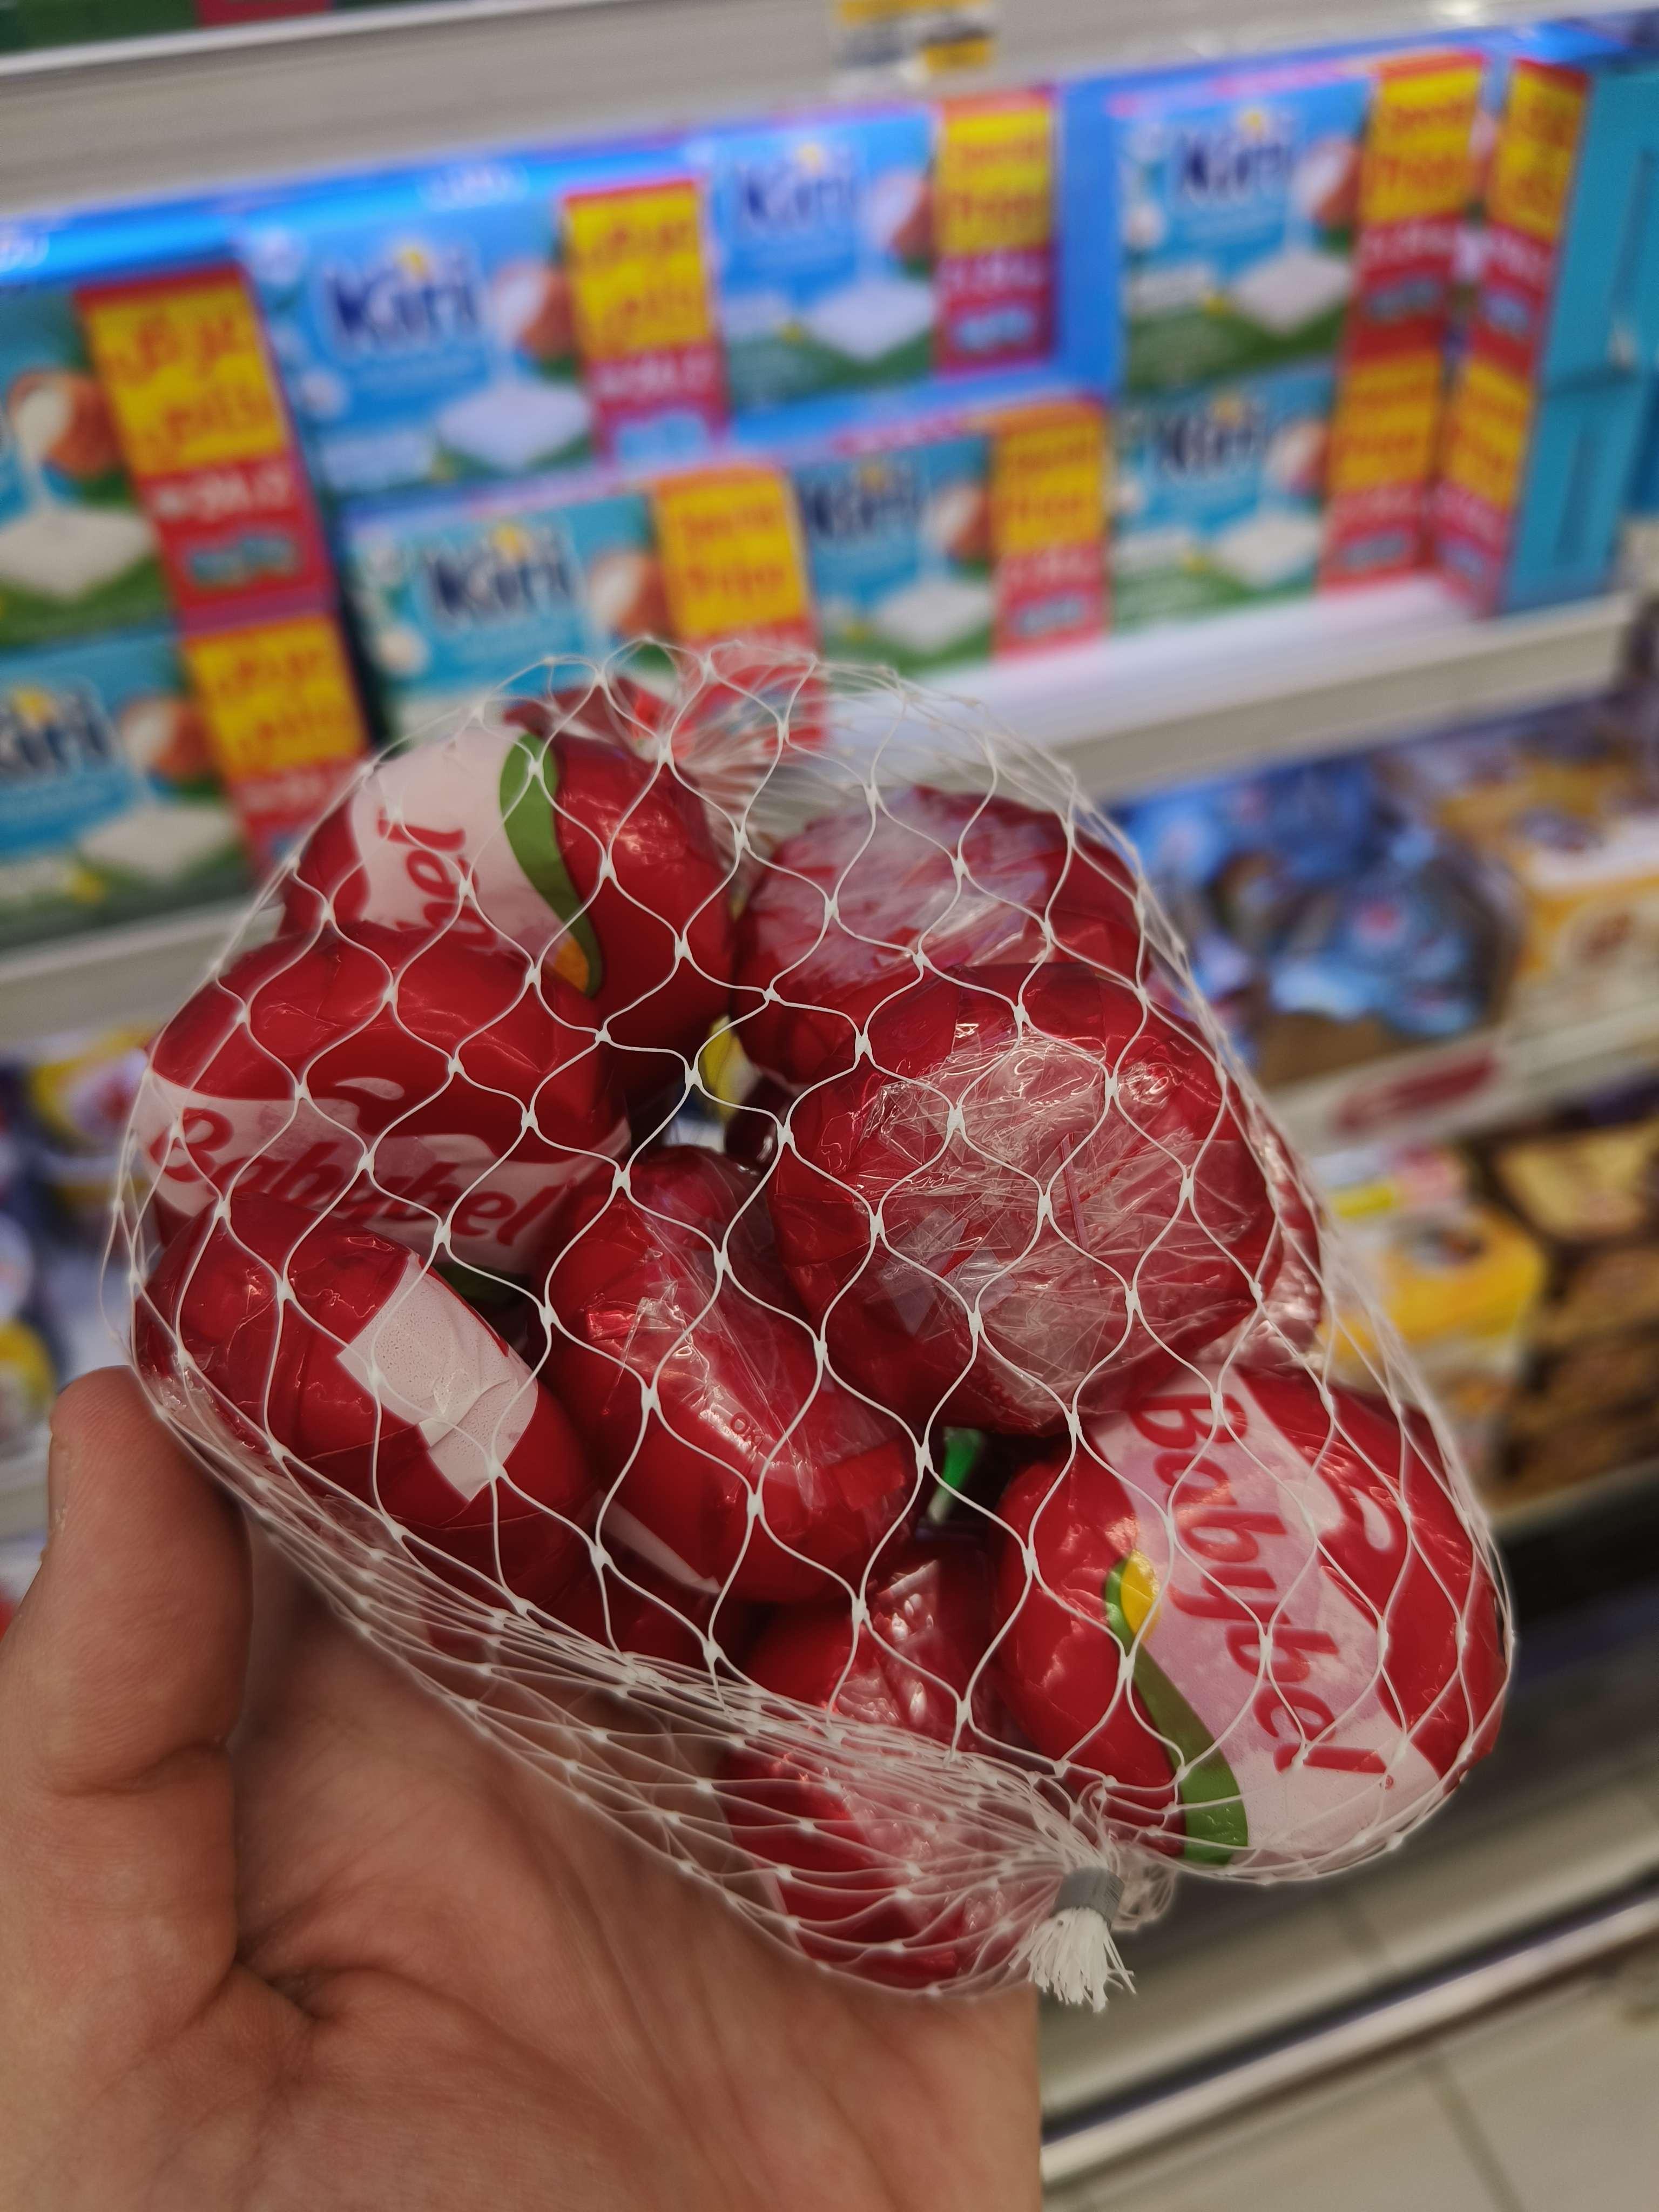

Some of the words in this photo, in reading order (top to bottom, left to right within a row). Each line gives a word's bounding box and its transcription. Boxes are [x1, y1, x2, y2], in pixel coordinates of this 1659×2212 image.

[325, 249, 482, 350] Kiri
[424, 524, 575, 621] Kiri
[1126, 1391, 1389, 1774] Babybel
